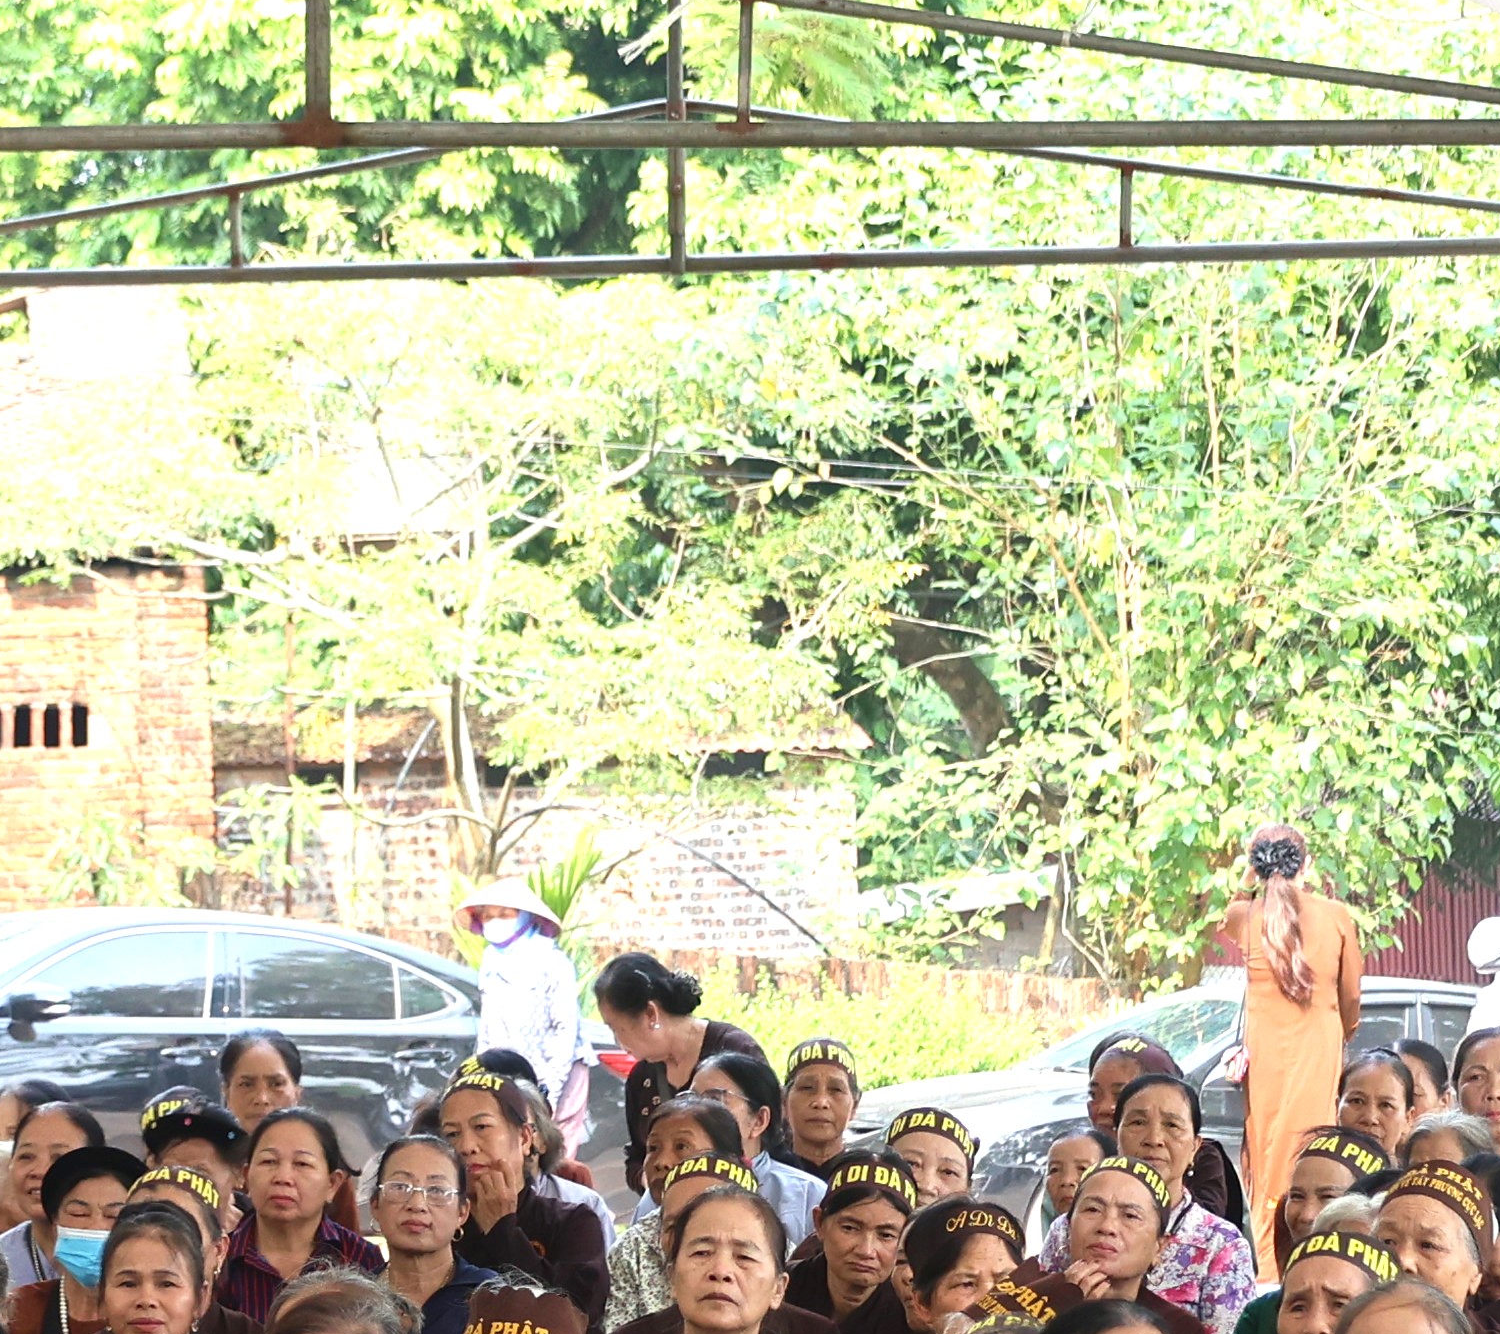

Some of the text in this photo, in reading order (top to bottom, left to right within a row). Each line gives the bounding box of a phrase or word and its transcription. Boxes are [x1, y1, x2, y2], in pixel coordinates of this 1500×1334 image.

[909, 1111, 936, 1128] ĐÀ
[831, 1170, 844, 1191] A
[846, 1165, 869, 1183] DI
[874, 1166, 901, 1192] ĐÀ
[946, 1210, 968, 1232] A
